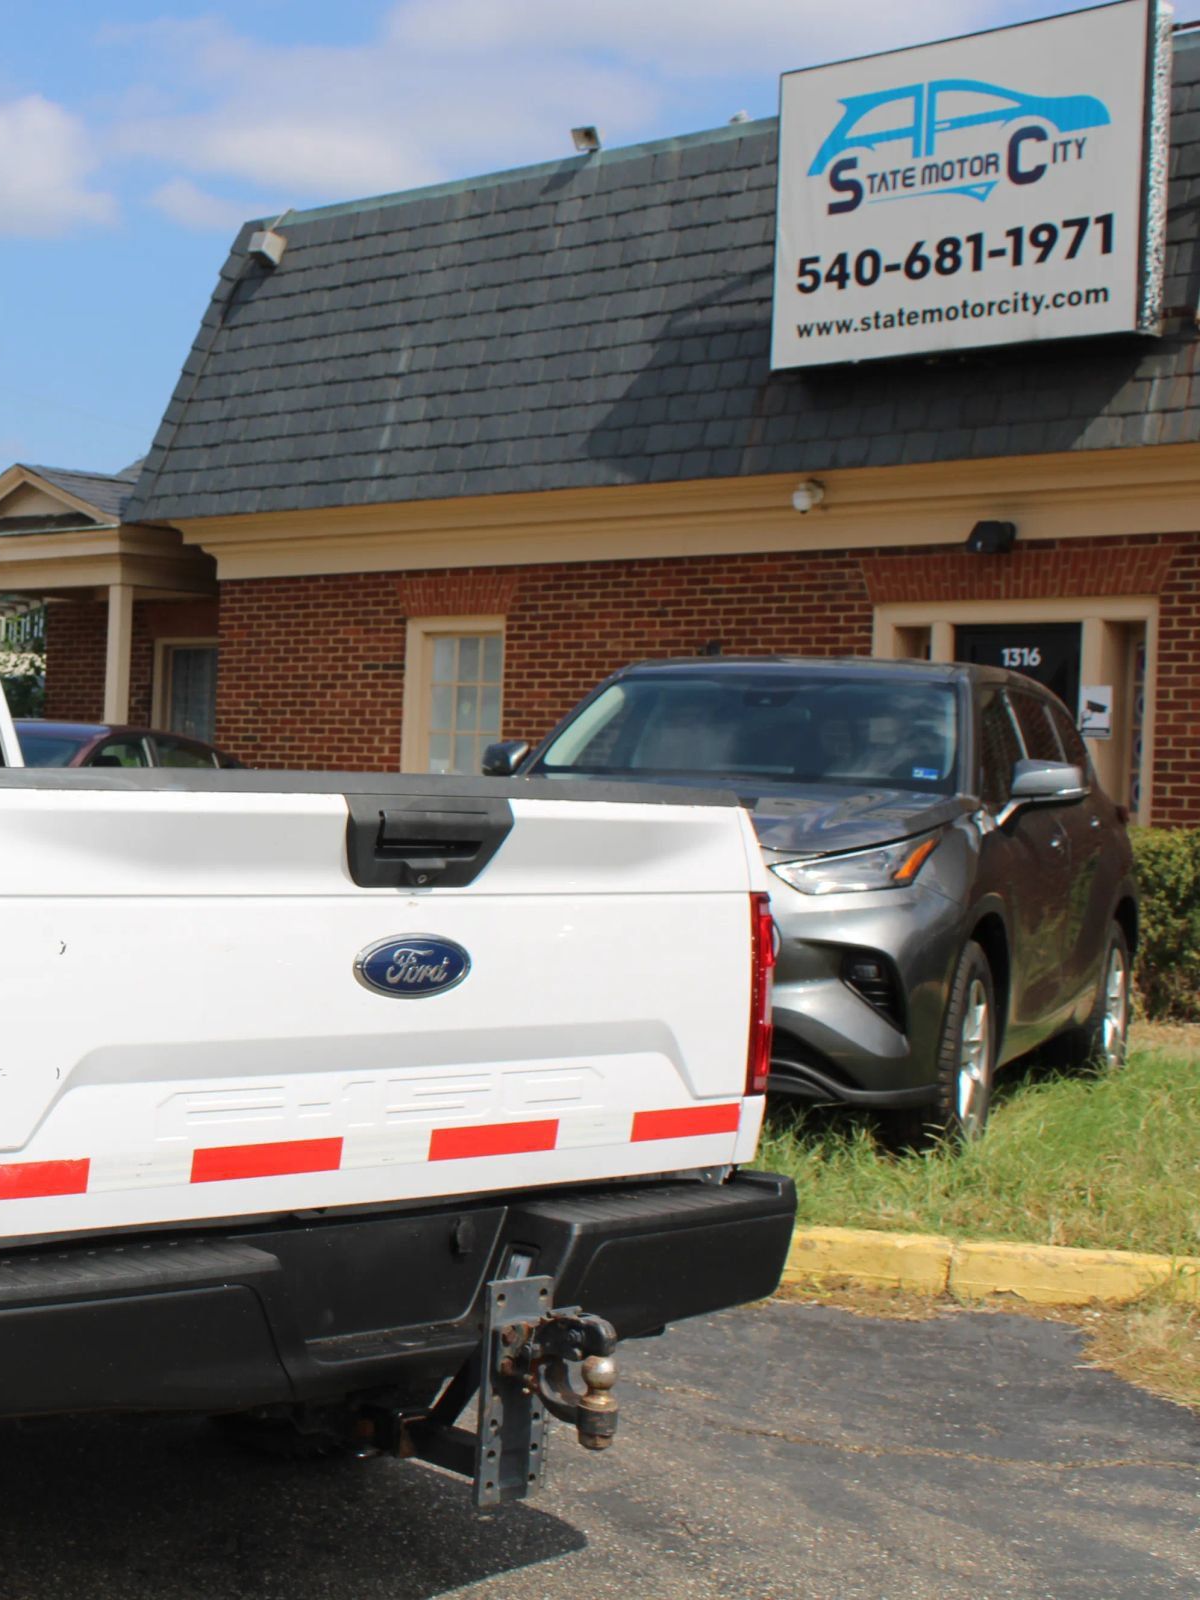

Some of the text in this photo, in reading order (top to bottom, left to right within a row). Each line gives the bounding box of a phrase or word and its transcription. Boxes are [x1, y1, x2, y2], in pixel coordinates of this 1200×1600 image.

[921, 152, 1000, 186] MOTOR
[1006, 124, 1088, 186] CITY
[796, 212, 1114, 295] 540-681-1971
[796, 286, 1110, 338] www.statemotorcity.com
[1001, 647, 1042, 667] 1316
[385, 947, 450, 985] Ford
